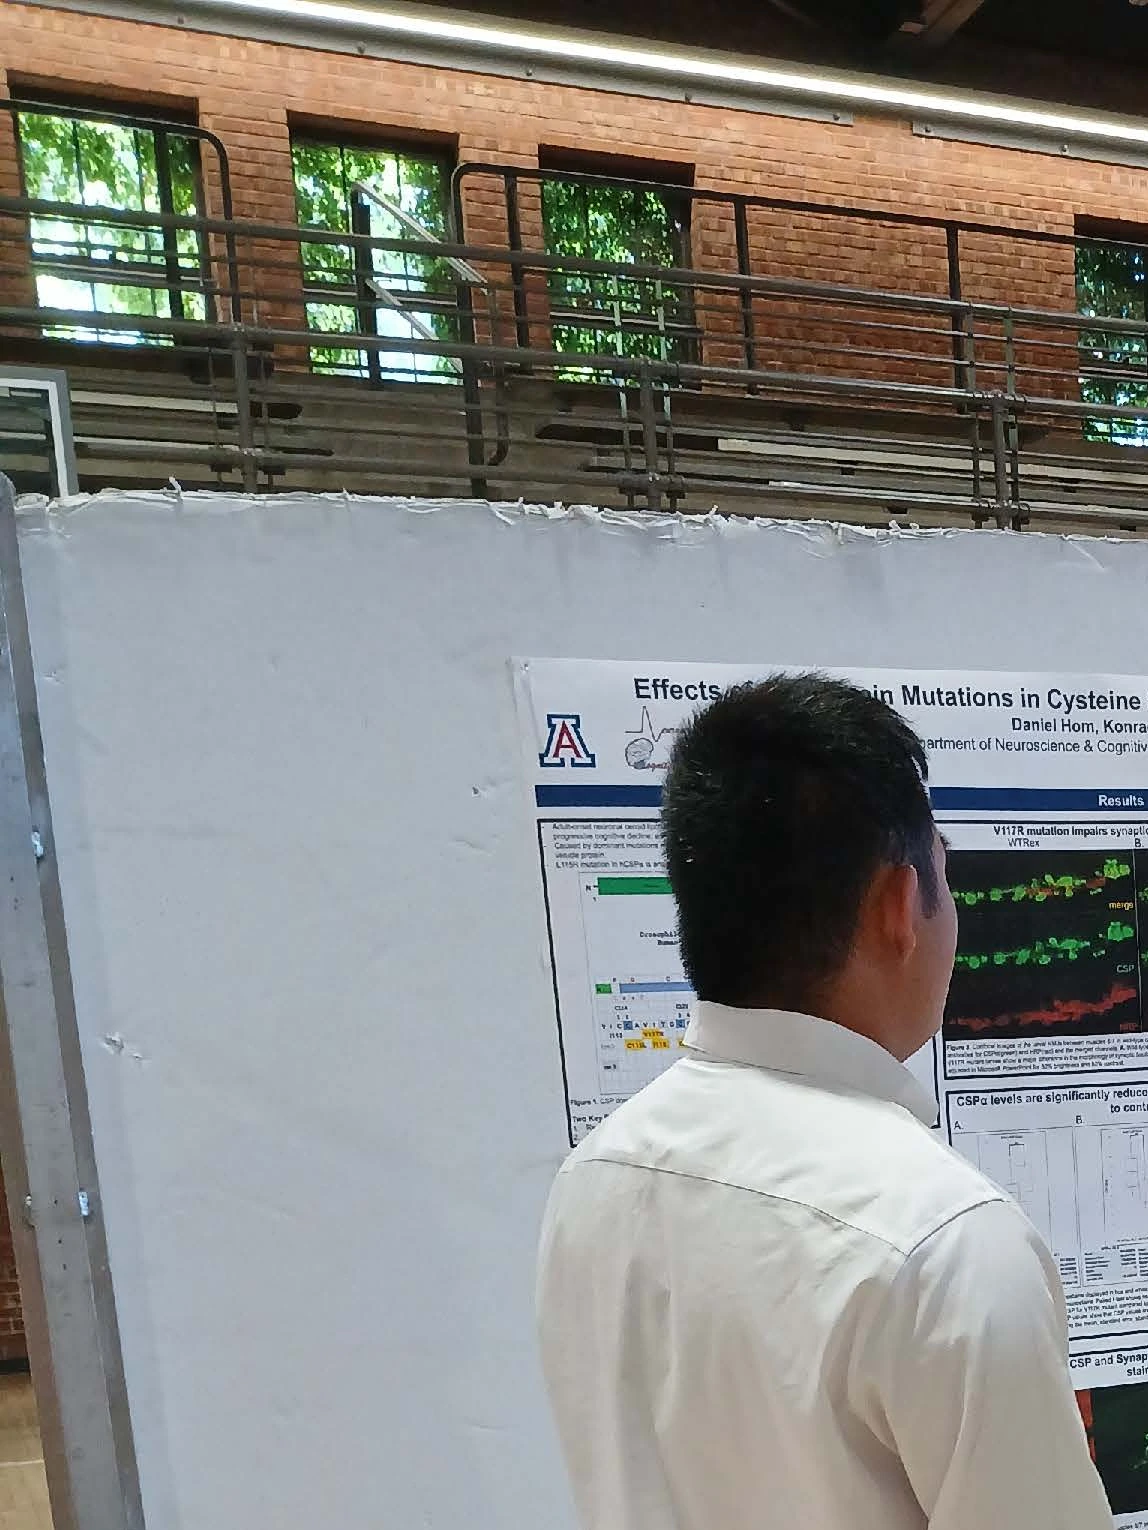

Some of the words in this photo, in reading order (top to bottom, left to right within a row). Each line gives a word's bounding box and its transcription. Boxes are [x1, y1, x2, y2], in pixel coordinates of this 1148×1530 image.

[633, 677, 721, 701] Effects
[901, 684, 1013, 708] Mutations
[1021, 687, 1040, 708] in
[1047, 688, 1142, 715] Cysteine
[1011, 718, 1056, 732] Daniel
[1061, 719, 1099, 735] Hom,
[979, 737, 991, 750] of
[996, 738, 1080, 753] Neuroscience
[1084, 740, 1094, 753] &
[1099, 795, 1145, 807] Results
[994, 826, 1025, 836] V117R
[1026, 825, 1069, 836] mutation
[1008, 838, 1040, 848] WTRex
[1135, 837, 1145, 848] B.
[990, 1093, 1022, 1106] levels
[1025, 1094, 1043, 1105] are
[1045, 1089, 1110, 1105] significantly
[1110, 1102, 1122, 1113] to
[953, 1120, 964, 1131] A.
[1075, 1115, 1085, 1125] B.
[1070, 1357, 1092, 1369] CSP
[1094, 1354, 1114, 1366] and
